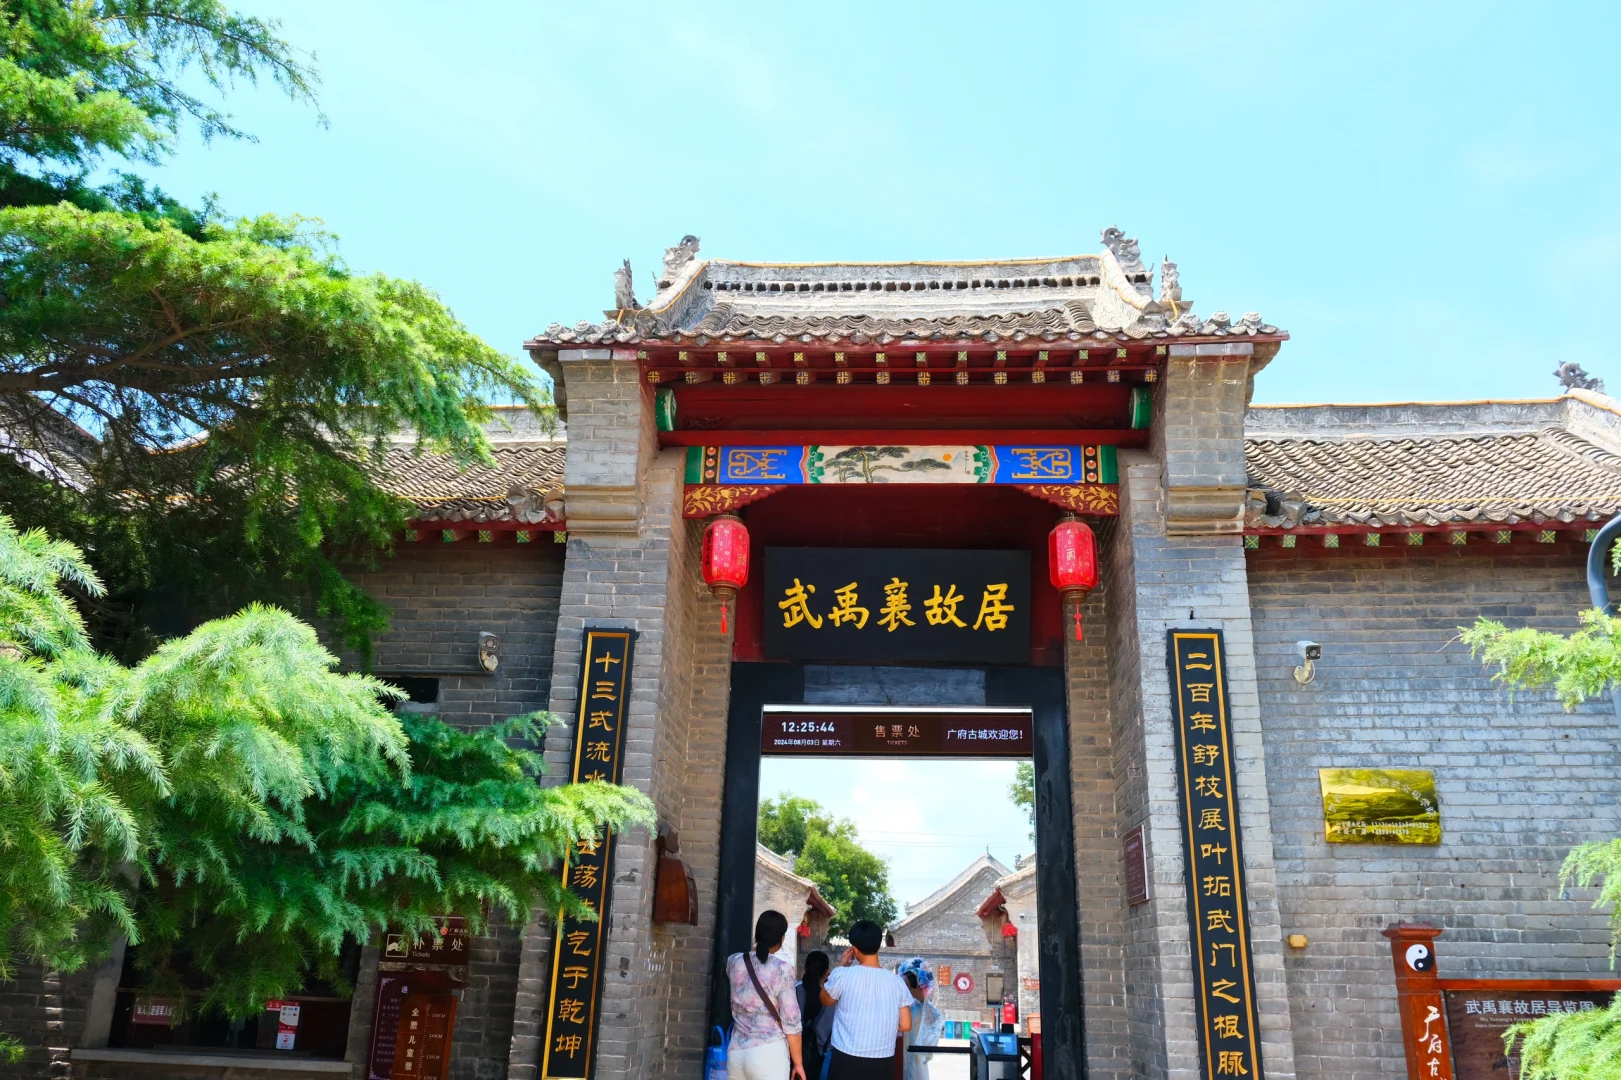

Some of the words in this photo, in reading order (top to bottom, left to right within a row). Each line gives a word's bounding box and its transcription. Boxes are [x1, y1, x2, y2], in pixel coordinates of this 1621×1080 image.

[777, 577, 1015, 632] 武禹襄故居
[781, 722, 835, 732] 12:25:44
[874, 724, 920, 738] 售票处
[555, 651, 621, 1059] 十三式流水云荡气于乾坤
[412, 937, 464, 951] 补票处
[1465, 1000, 1594, 1015] 武禹襄故居导览图
[404, 1035, 417, 1071] 儿童票
[1418, 1005, 1447, 1080] 广府古
